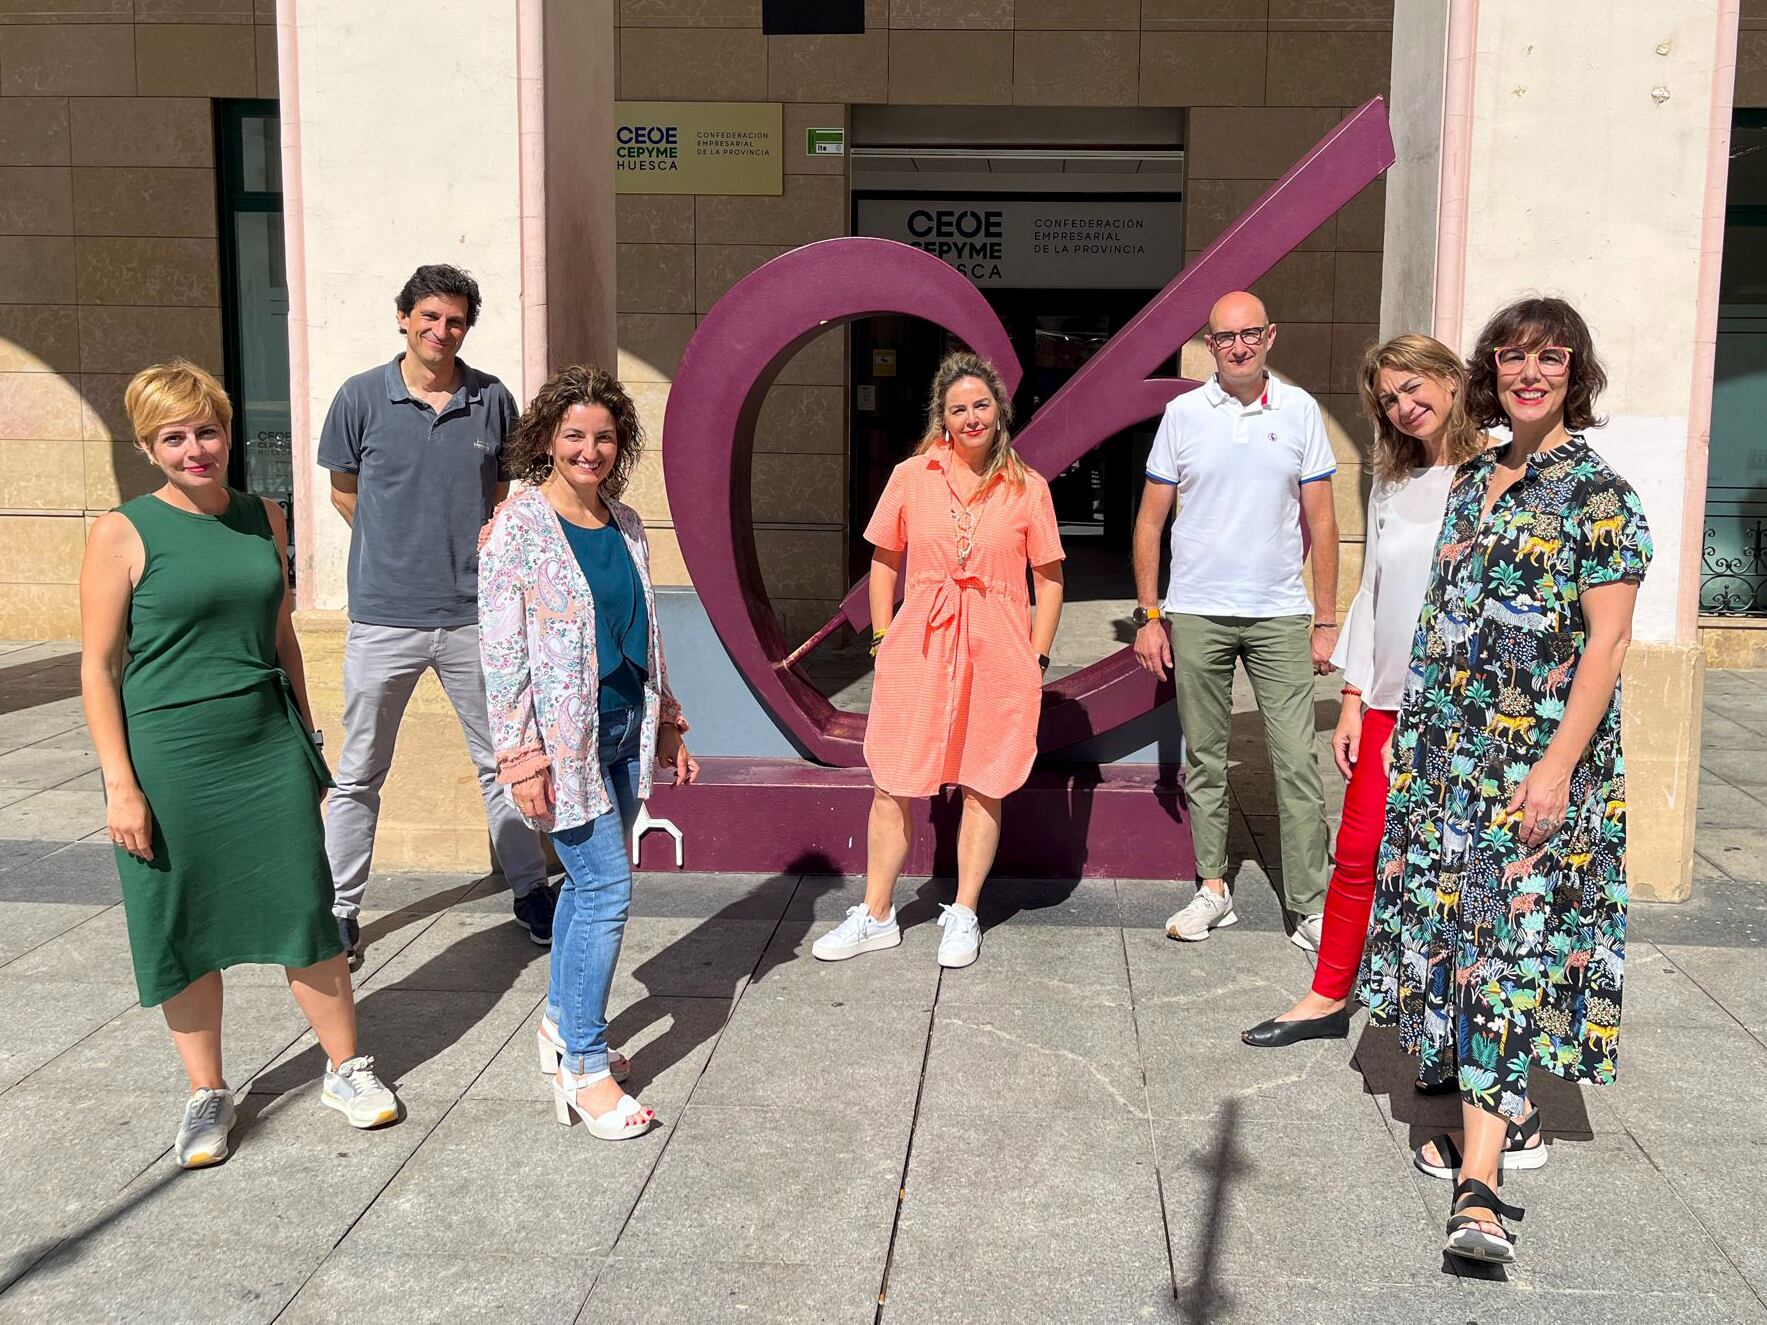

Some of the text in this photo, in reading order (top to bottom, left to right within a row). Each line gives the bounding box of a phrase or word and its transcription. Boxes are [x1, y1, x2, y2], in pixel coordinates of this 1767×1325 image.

[616, 126, 678, 145] CEOE
[697, 140, 754, 148] EMPRESARIAL
[616, 146, 678, 159] CEPYME
[697, 148, 770, 157] DE LA PROVINCIA
[616, 160, 678, 171] HUESCA
[907, 209, 1003, 239] CEOE
[1034, 231, 1121, 241] EMPRESARIAL
[1034, 244, 1145, 254] DE LA PROVINCIA
